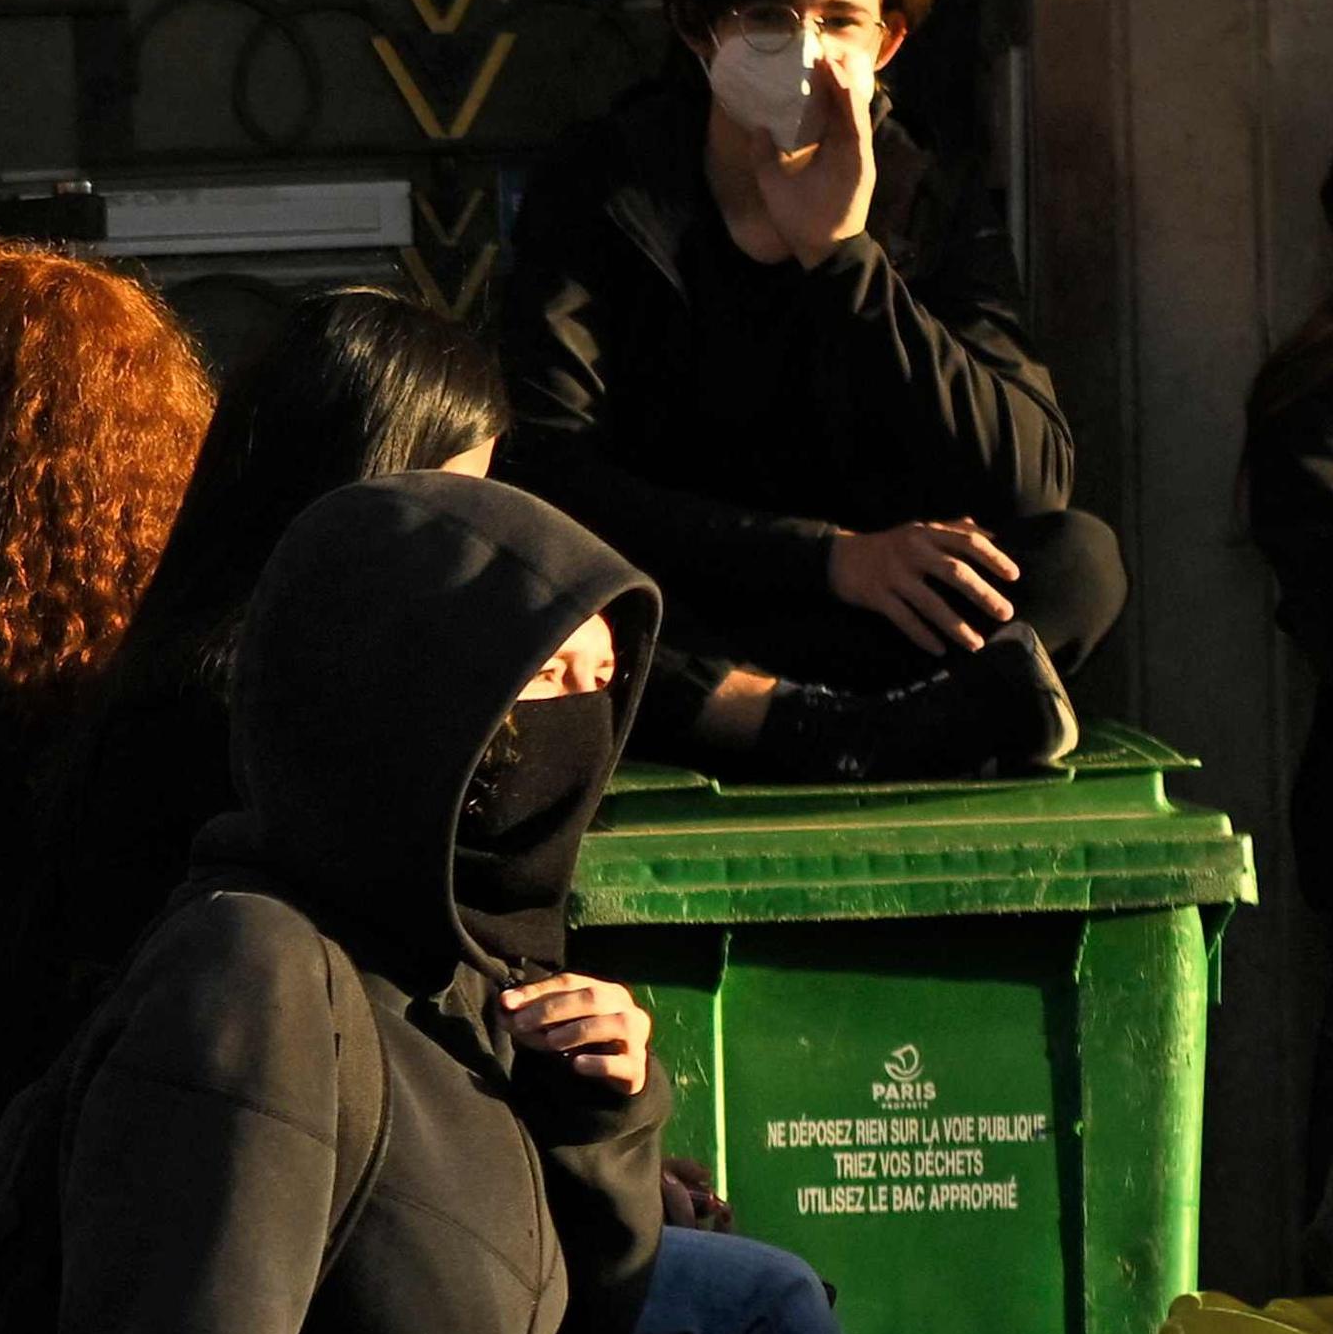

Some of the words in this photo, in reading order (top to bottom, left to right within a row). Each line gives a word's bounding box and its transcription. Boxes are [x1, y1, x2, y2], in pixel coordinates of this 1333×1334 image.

[872, 1081, 937, 1101] PARIS
[767, 1120, 788, 1149] NE
[790, 1113, 852, 1147] DÉPOSEZ
[855, 1118, 887, 1146] RIEN
[890, 1117, 919, 1145] SUR
[922, 1117, 940, 1144] LA
[942, 1116, 976, 1143] VOIE
[978, 1114, 1046, 1142] PUBLIQUE
[834, 1151, 877, 1180] TRIEZ
[881, 1150, 911, 1178] VOS
[916, 1143, 984, 1178] DÉCHETS
[797, 1186, 866, 1214] UTILISEZ
[869, 1186, 889, 1213] LE
[892, 1184, 925, 1212] BAC
[929, 1175, 1018, 1211] APPROPRIÉ
